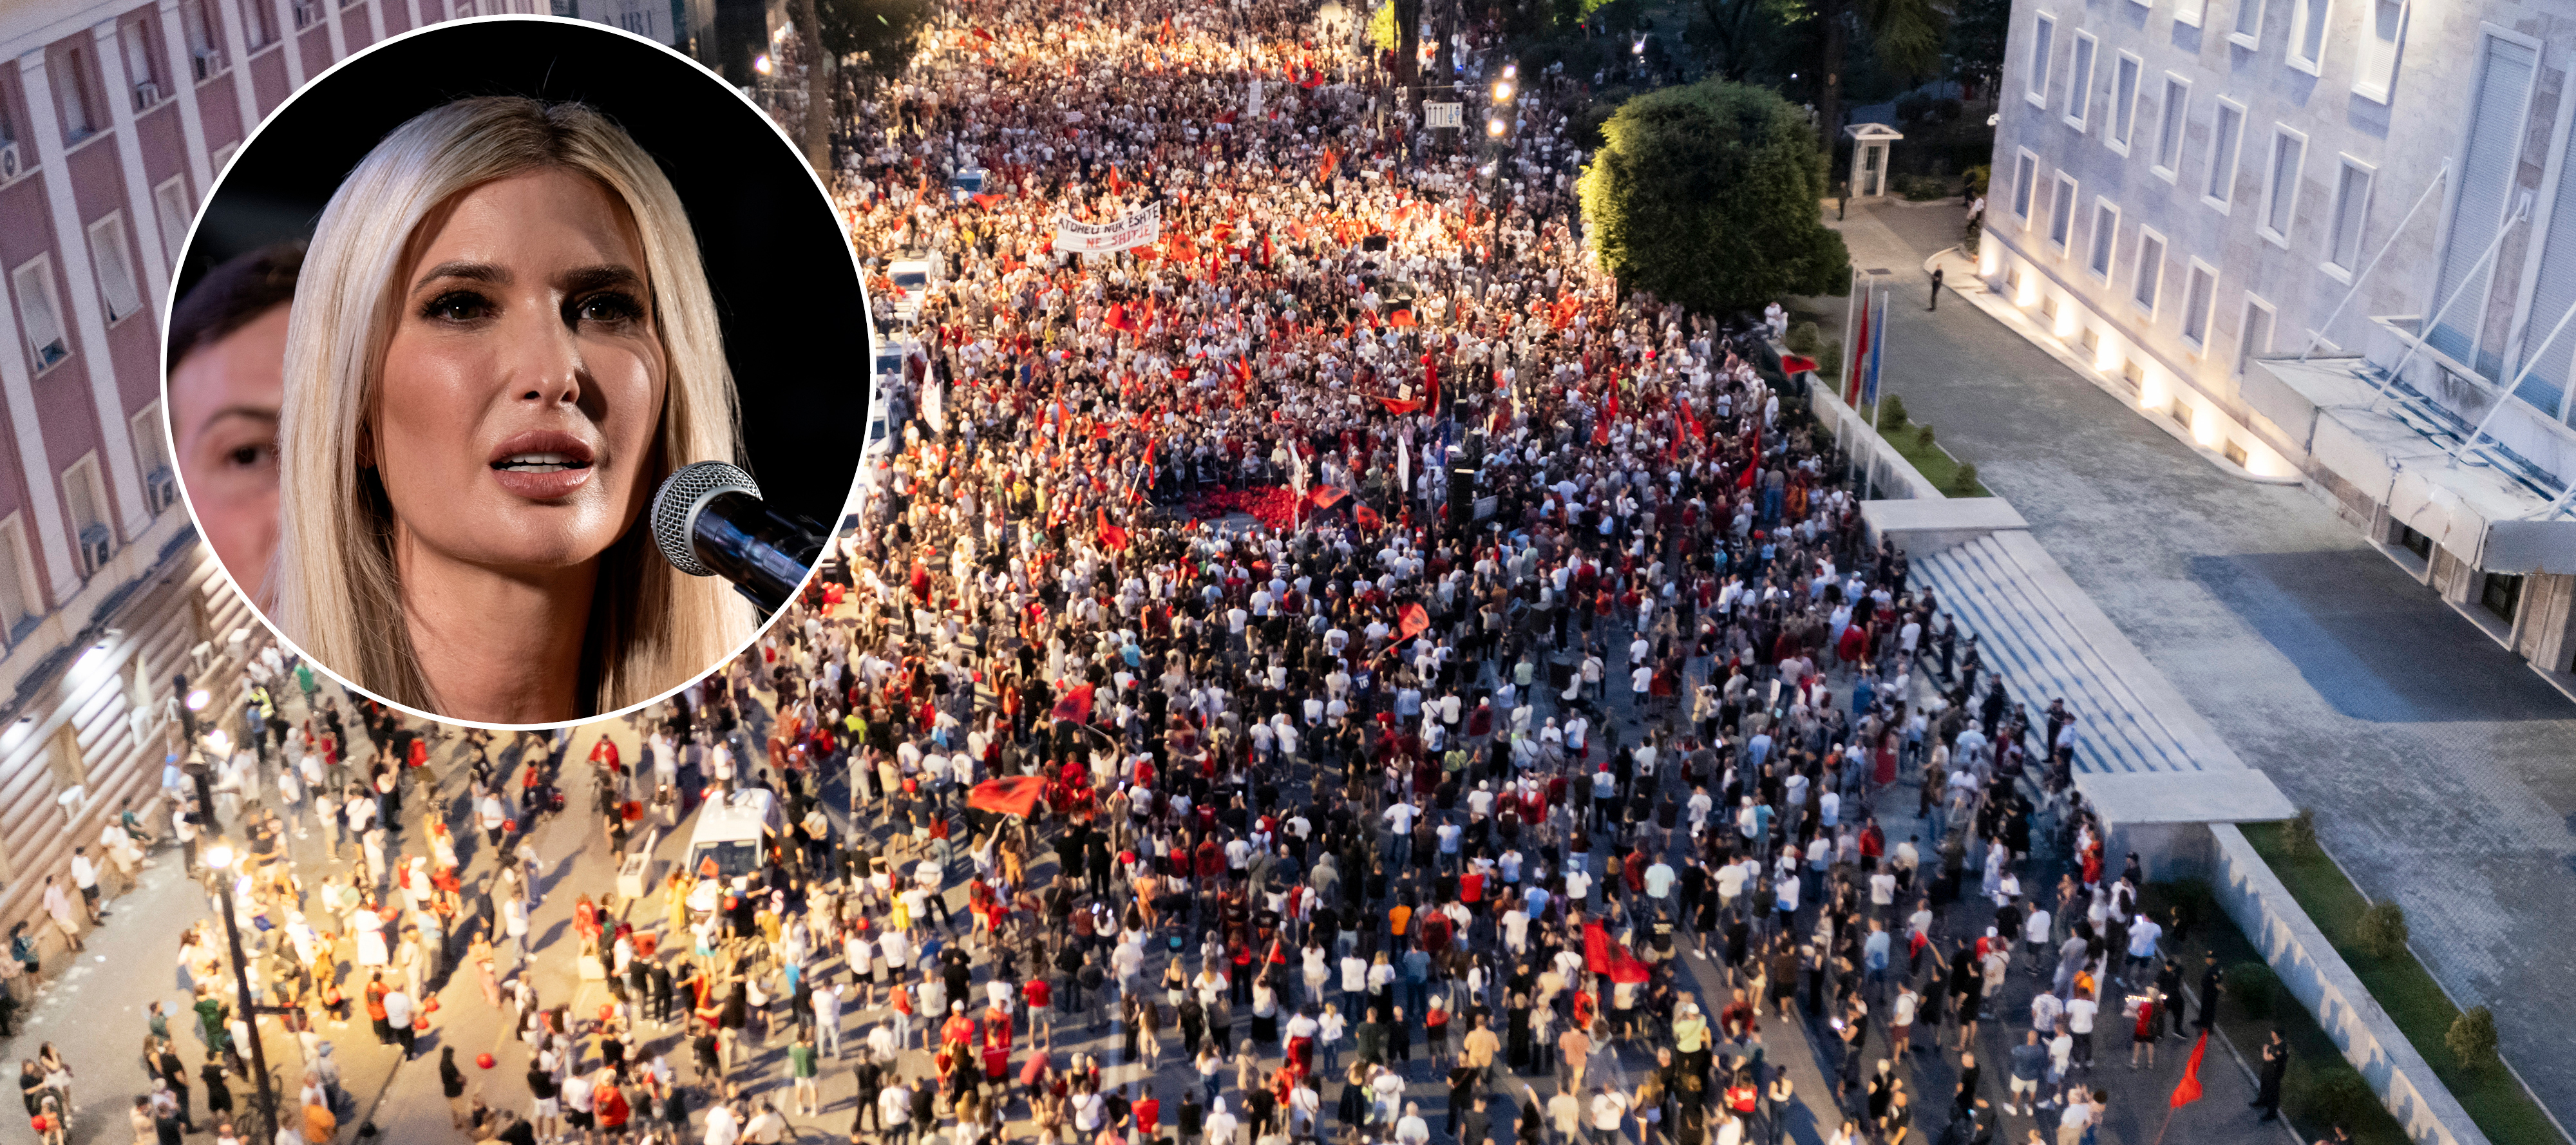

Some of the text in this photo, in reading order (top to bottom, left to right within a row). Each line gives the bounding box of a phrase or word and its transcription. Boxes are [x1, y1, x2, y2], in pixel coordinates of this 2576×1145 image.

[1058, 218, 1100, 234] ATDHEU
[1104, 222, 1124, 233] NUK
[1086, 225, 1151, 249] NE SHITJE
